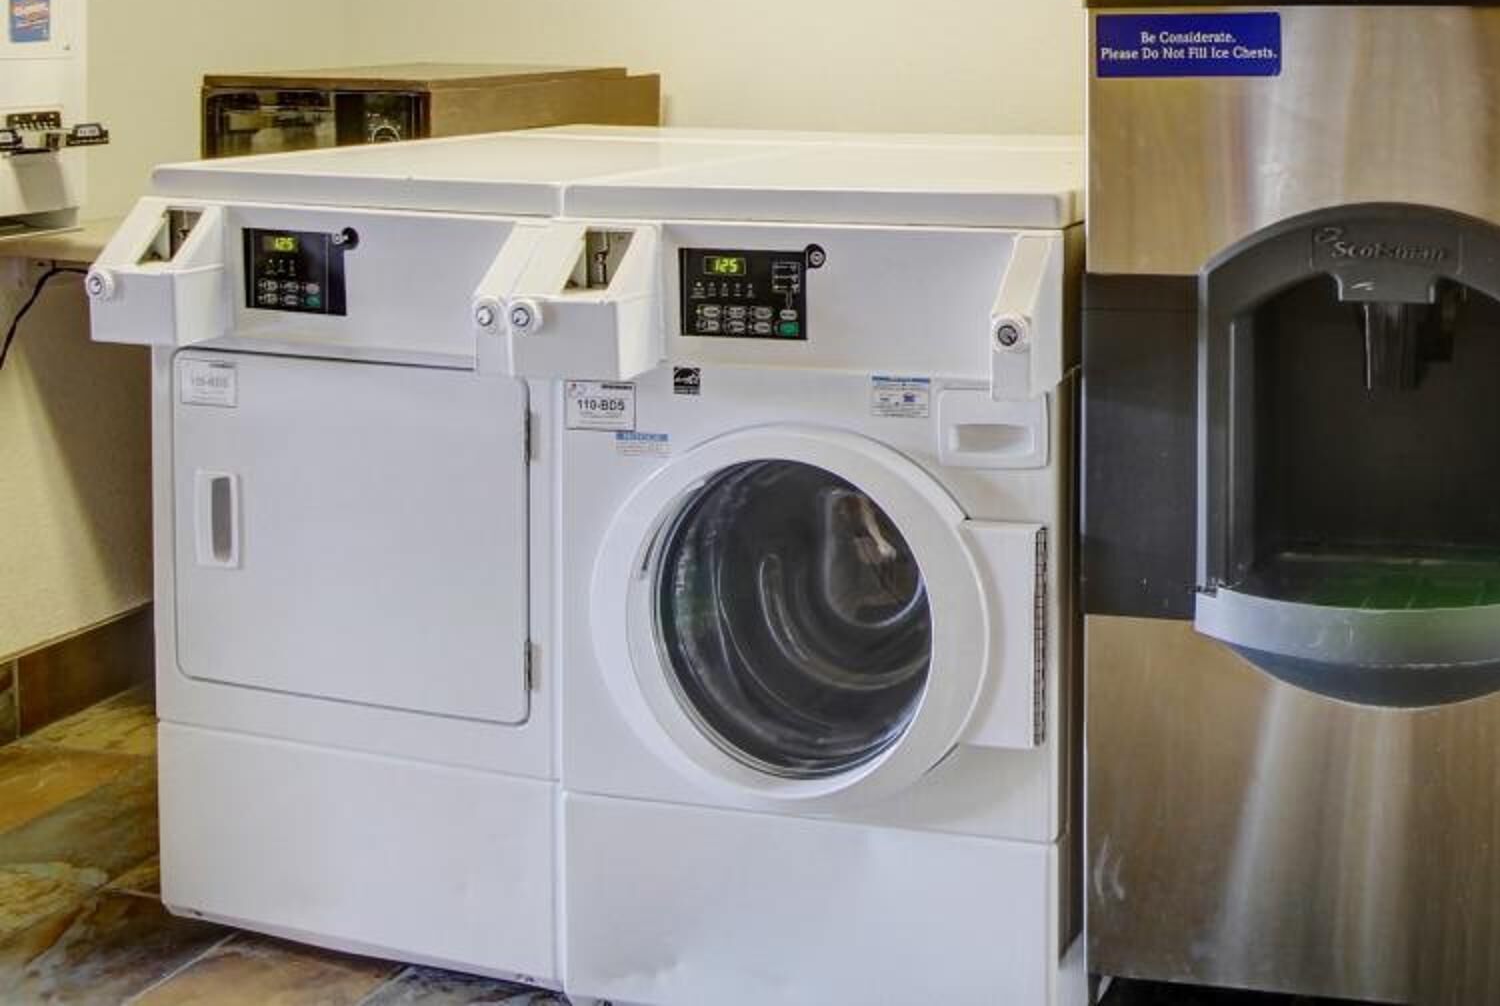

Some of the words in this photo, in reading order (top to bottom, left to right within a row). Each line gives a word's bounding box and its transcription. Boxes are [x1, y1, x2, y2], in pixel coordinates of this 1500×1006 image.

[1141, 32, 1156, 43] Be
[1159, 30, 1237, 44] Considerate.
[1100, 47, 1138, 60] Please
[1141, 47, 1159, 60] Do
[1162, 47, 1185, 59] Not
[1188, 46, 1208, 59] Fill
[1211, 46, 1229, 59] Ice
[1232, 45, 1278, 59] Chests.
[714, 257, 738, 273] 125
